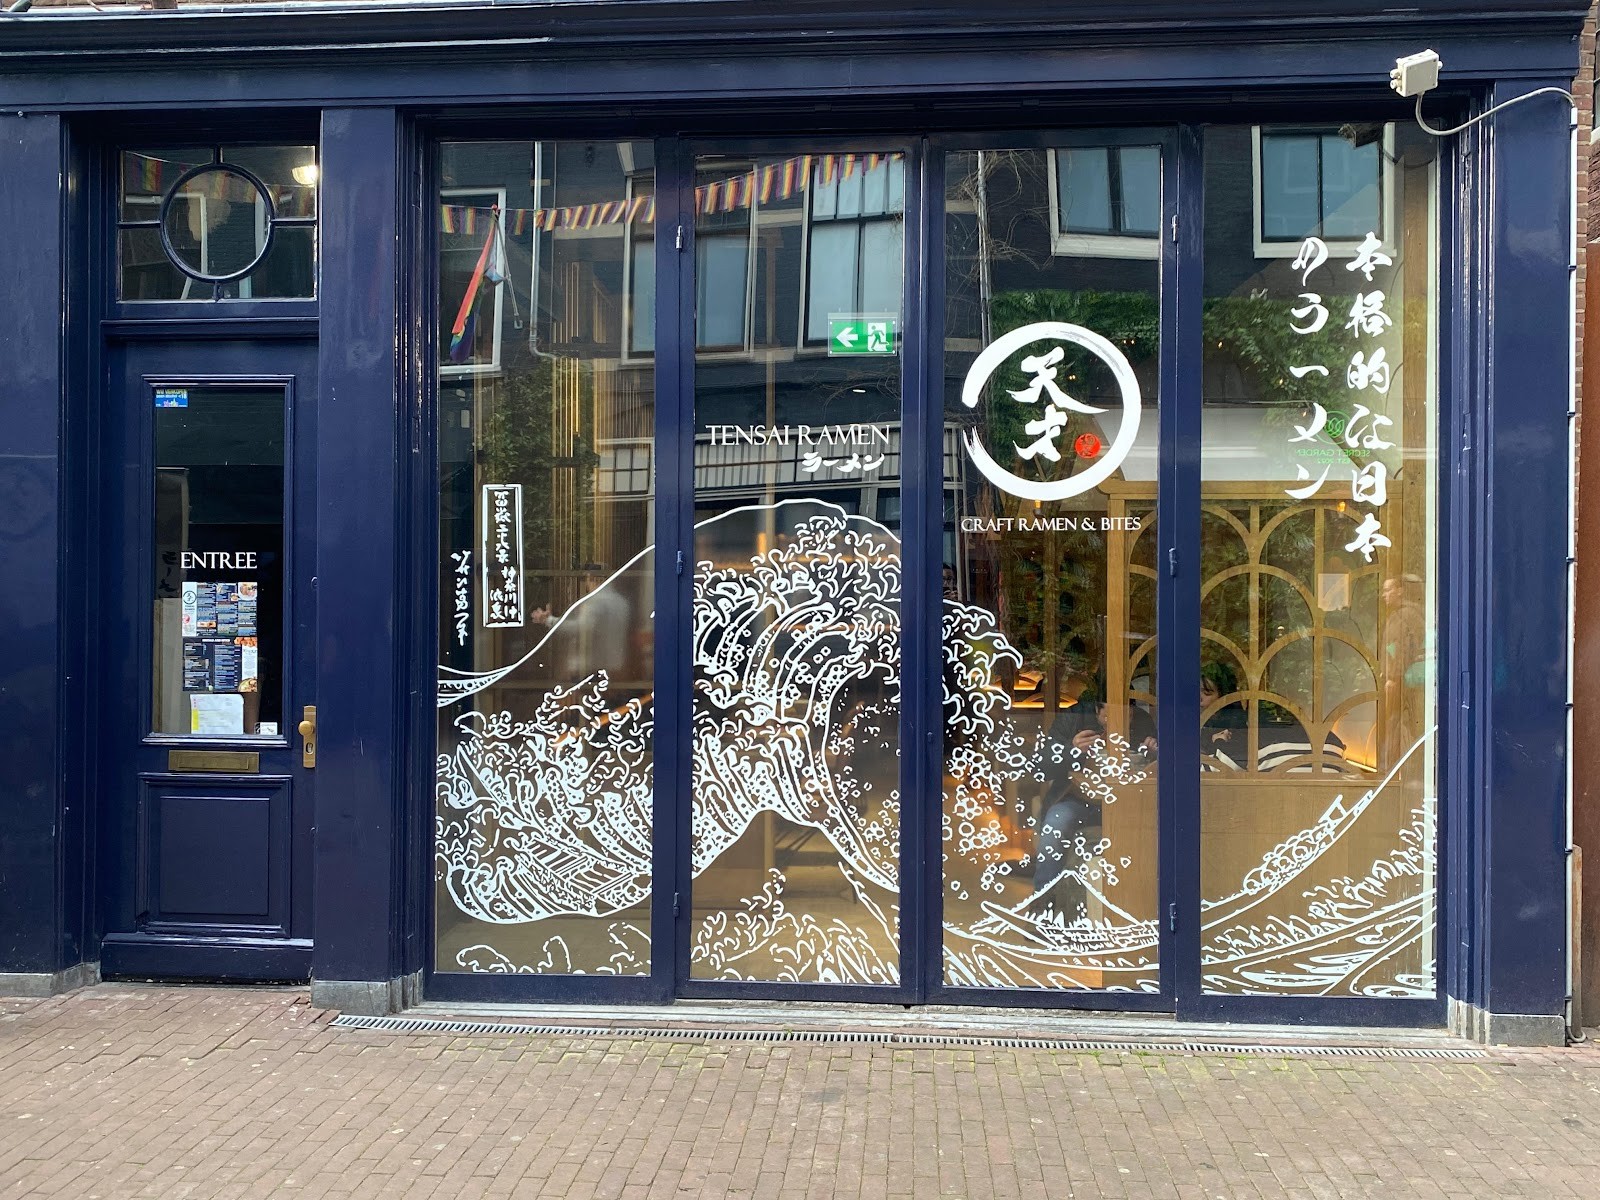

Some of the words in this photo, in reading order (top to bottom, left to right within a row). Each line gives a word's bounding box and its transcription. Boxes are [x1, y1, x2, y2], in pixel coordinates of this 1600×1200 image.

[705, 424, 789, 446] TENSAI
[798, 424, 890, 446] RAMEN
[802, 452, 885, 473] ラーメン
[961, 518, 1014, 532] CRAFT
[1018, 518, 1077, 531] RAMEN
[1081, 517, 1097, 531] &
[1101, 517, 1141, 531] BITES
[181, 551, 258, 569] ENTREE
